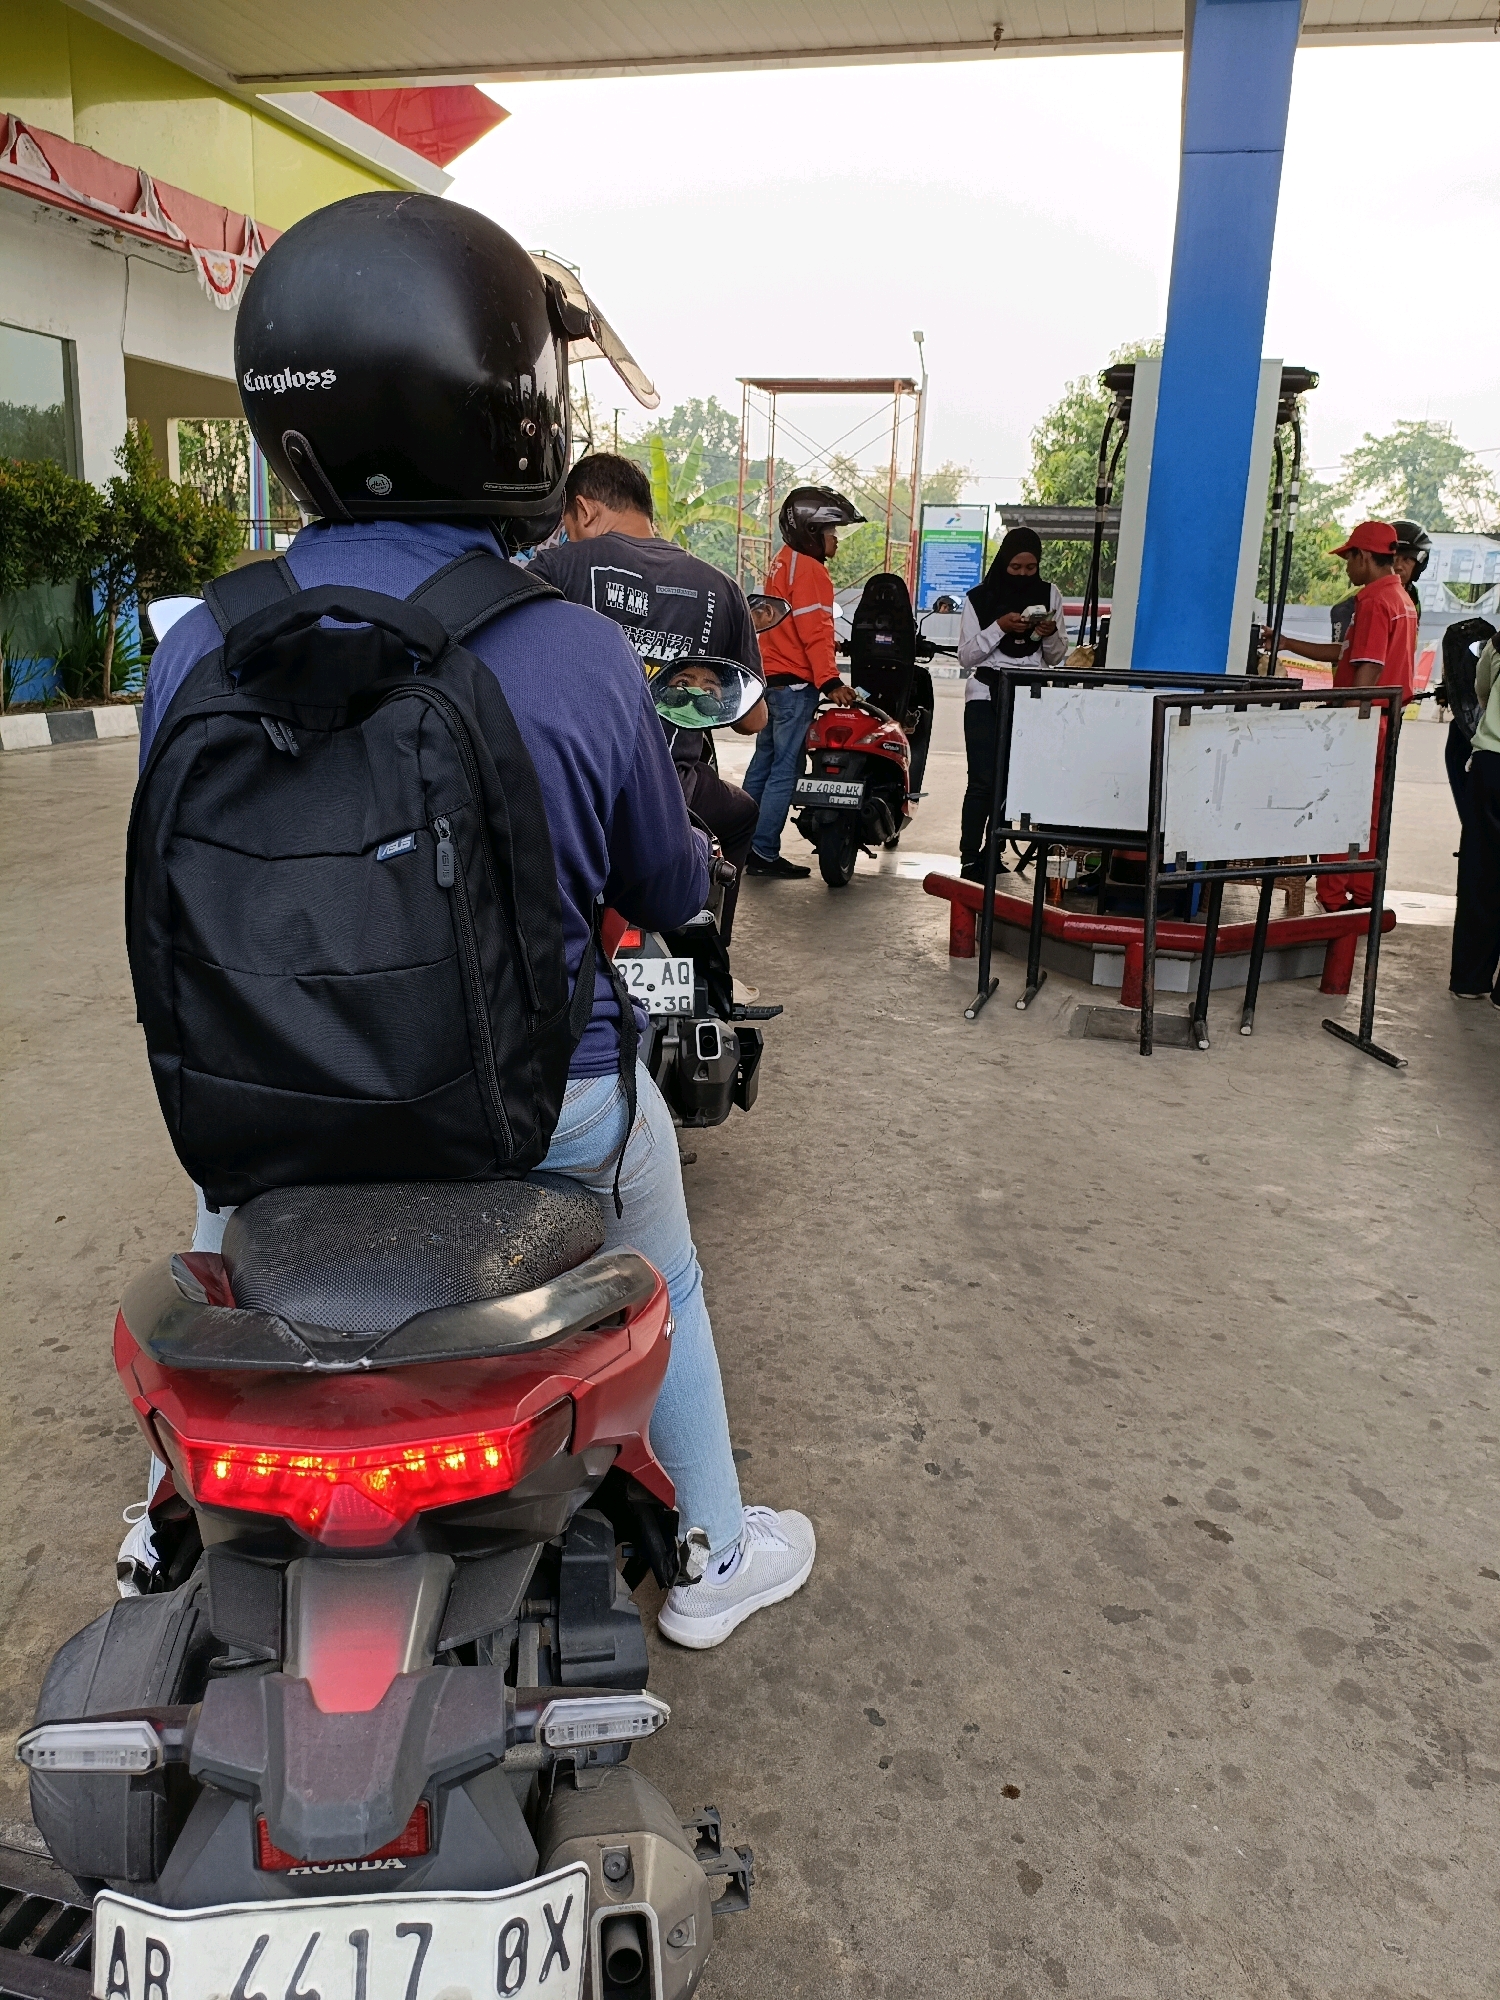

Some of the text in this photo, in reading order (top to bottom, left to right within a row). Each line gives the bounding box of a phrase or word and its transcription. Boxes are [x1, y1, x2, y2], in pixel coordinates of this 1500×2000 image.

[243, 366, 337, 395] Cargloss
[701, 590, 716, 644] LIMITED
[800, 781, 813, 792] AB
[816, 783, 842, 794] 4088
[381, 836, 412, 858] ASUS
[661, 961, 690, 986] AQ
